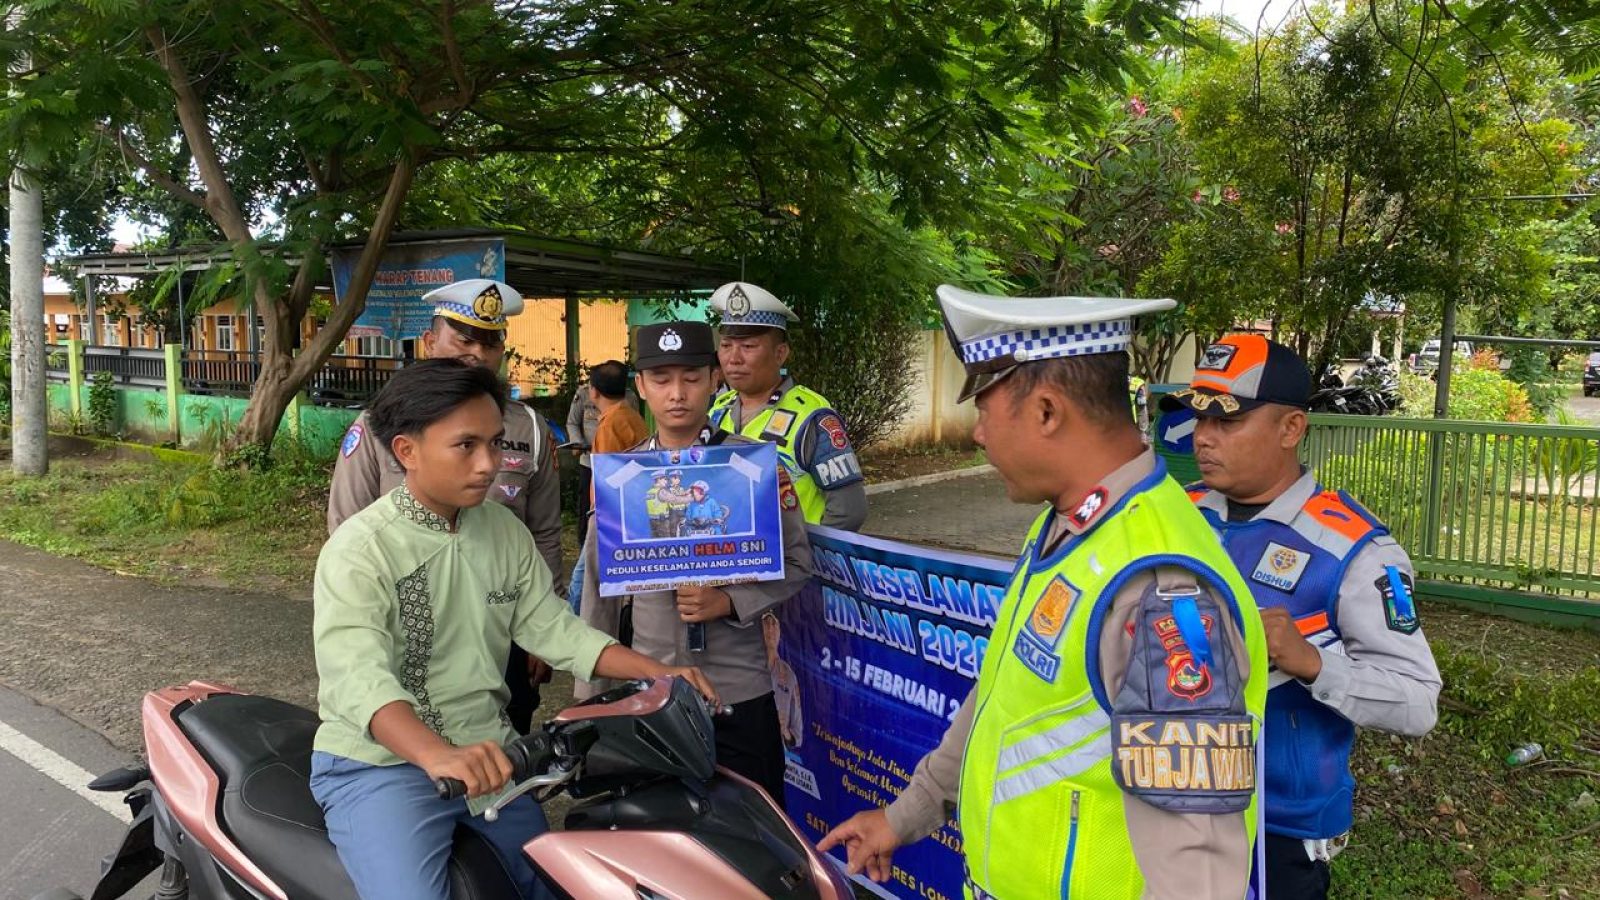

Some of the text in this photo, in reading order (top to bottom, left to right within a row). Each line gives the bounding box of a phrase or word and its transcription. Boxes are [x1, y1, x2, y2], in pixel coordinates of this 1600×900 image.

[409, 268, 454, 284] TENANG
[500, 440, 530, 453] OLRI
[614, 539, 766, 562] GUNAKAN HELM SNI
[607, 556, 772, 576] PEDULI KESELAMATAN ANDA SENDIRI
[1254, 571, 1293, 588] DISHUB
[822, 586, 917, 655] RINJANI
[820, 647, 831, 669] 2
[845, 656, 861, 682] 15
[863, 664, 946, 719] FEBRUARI
[1119, 721, 1251, 746] KANIT
